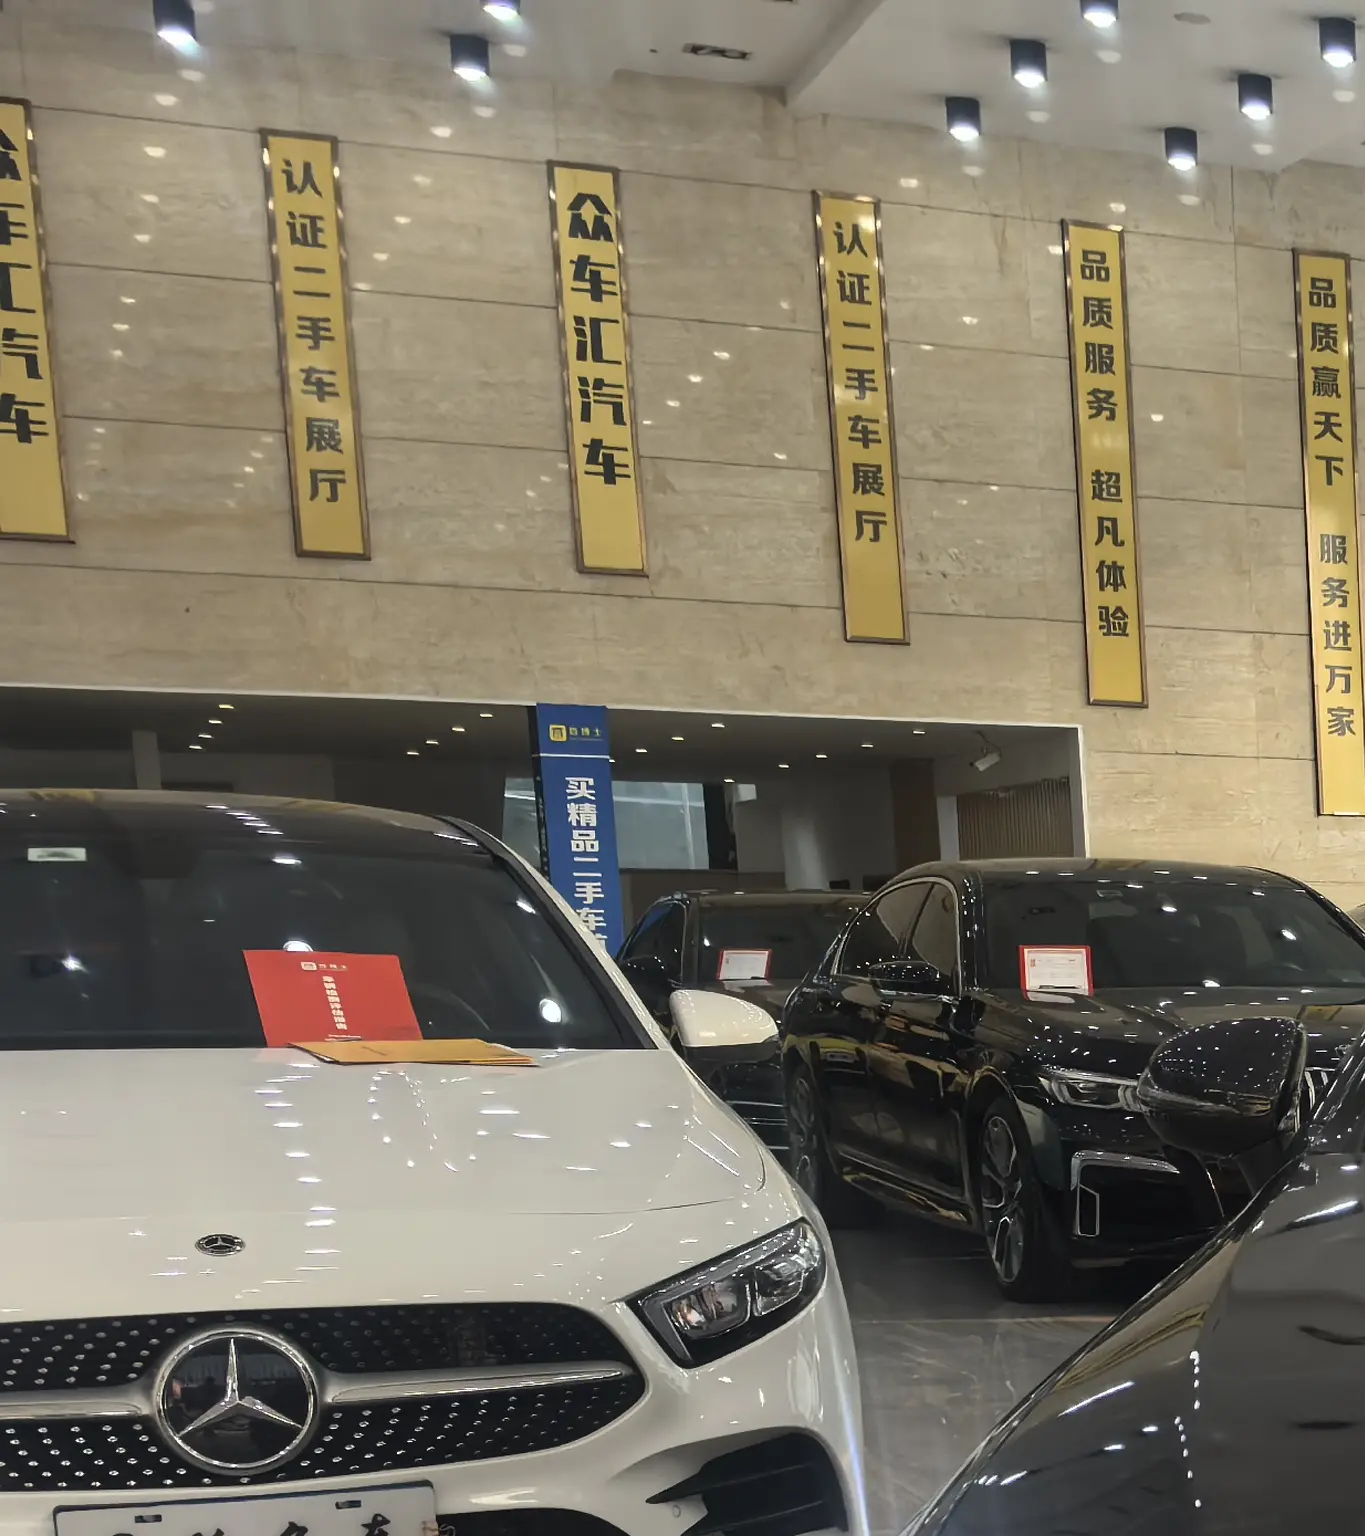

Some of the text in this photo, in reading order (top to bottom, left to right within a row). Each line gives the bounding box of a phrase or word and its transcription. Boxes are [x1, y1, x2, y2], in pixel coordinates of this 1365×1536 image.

[280, 158, 347, 504] 认证二手车展厅
[566, 192, 632, 486] 众车汇汽车
[832, 221, 889, 544] 认证二手车展厅
[1079, 249, 1130, 638] 品质服务 超凡体验
[1307, 276, 1356, 737] 品质赢天下 服务进万家
